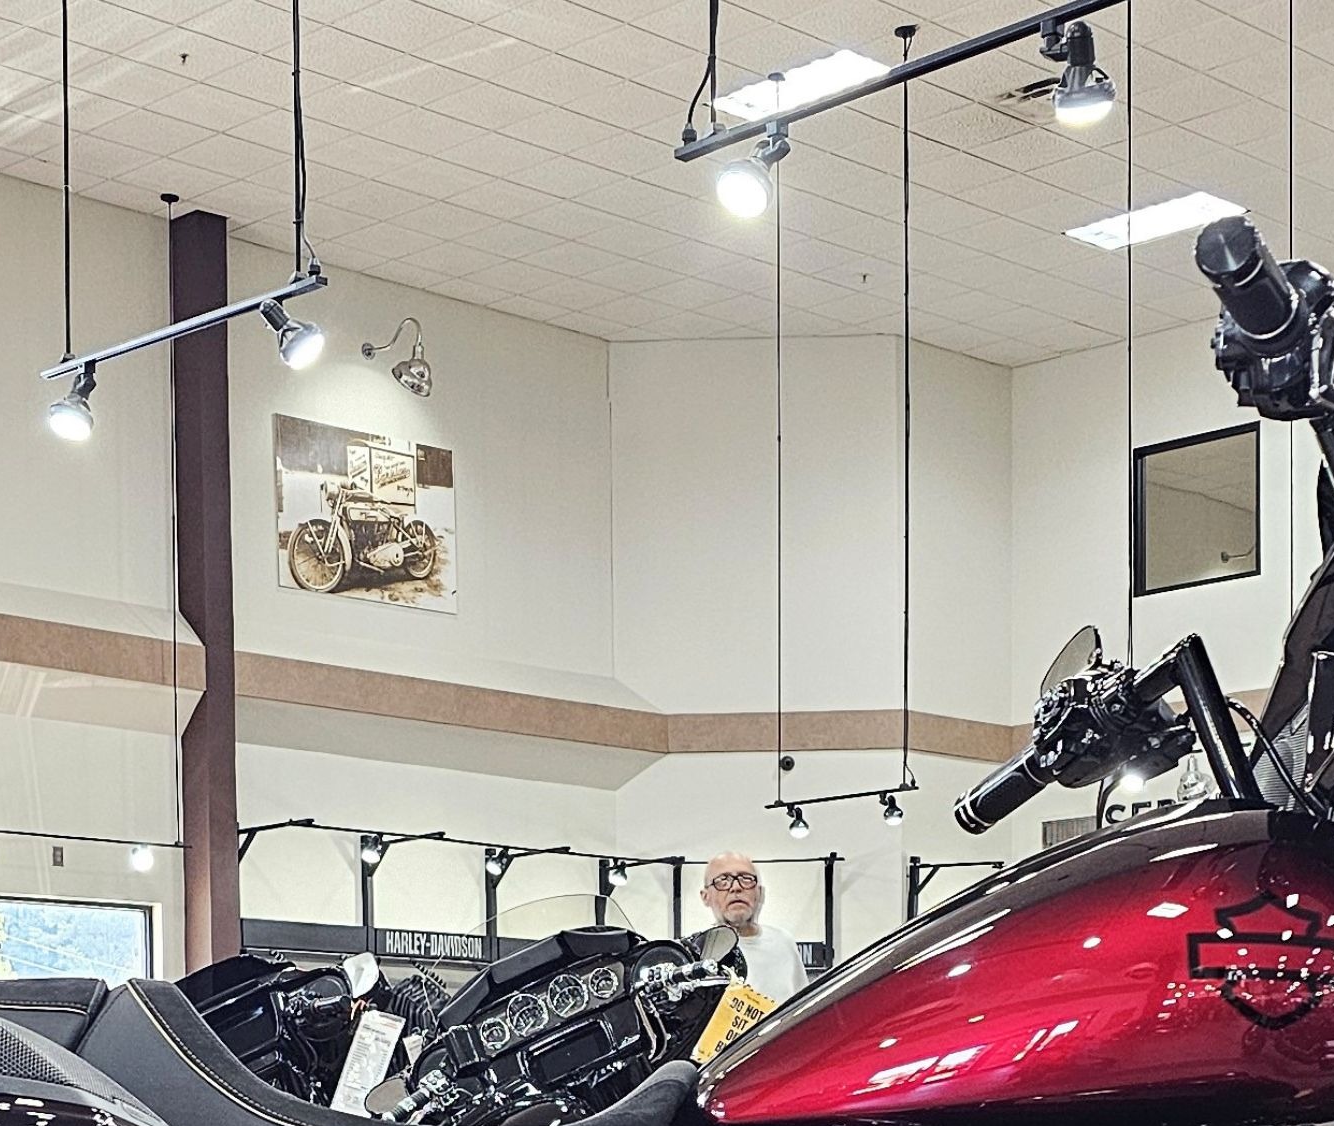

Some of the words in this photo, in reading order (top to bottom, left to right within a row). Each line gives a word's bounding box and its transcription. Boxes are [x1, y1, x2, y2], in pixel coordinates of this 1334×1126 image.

[386, 930, 483, 959] HARLEY-DAVIDSON
[743, 1003, 766, 1021] NOT
[731, 1015, 749, 1031] SIT
